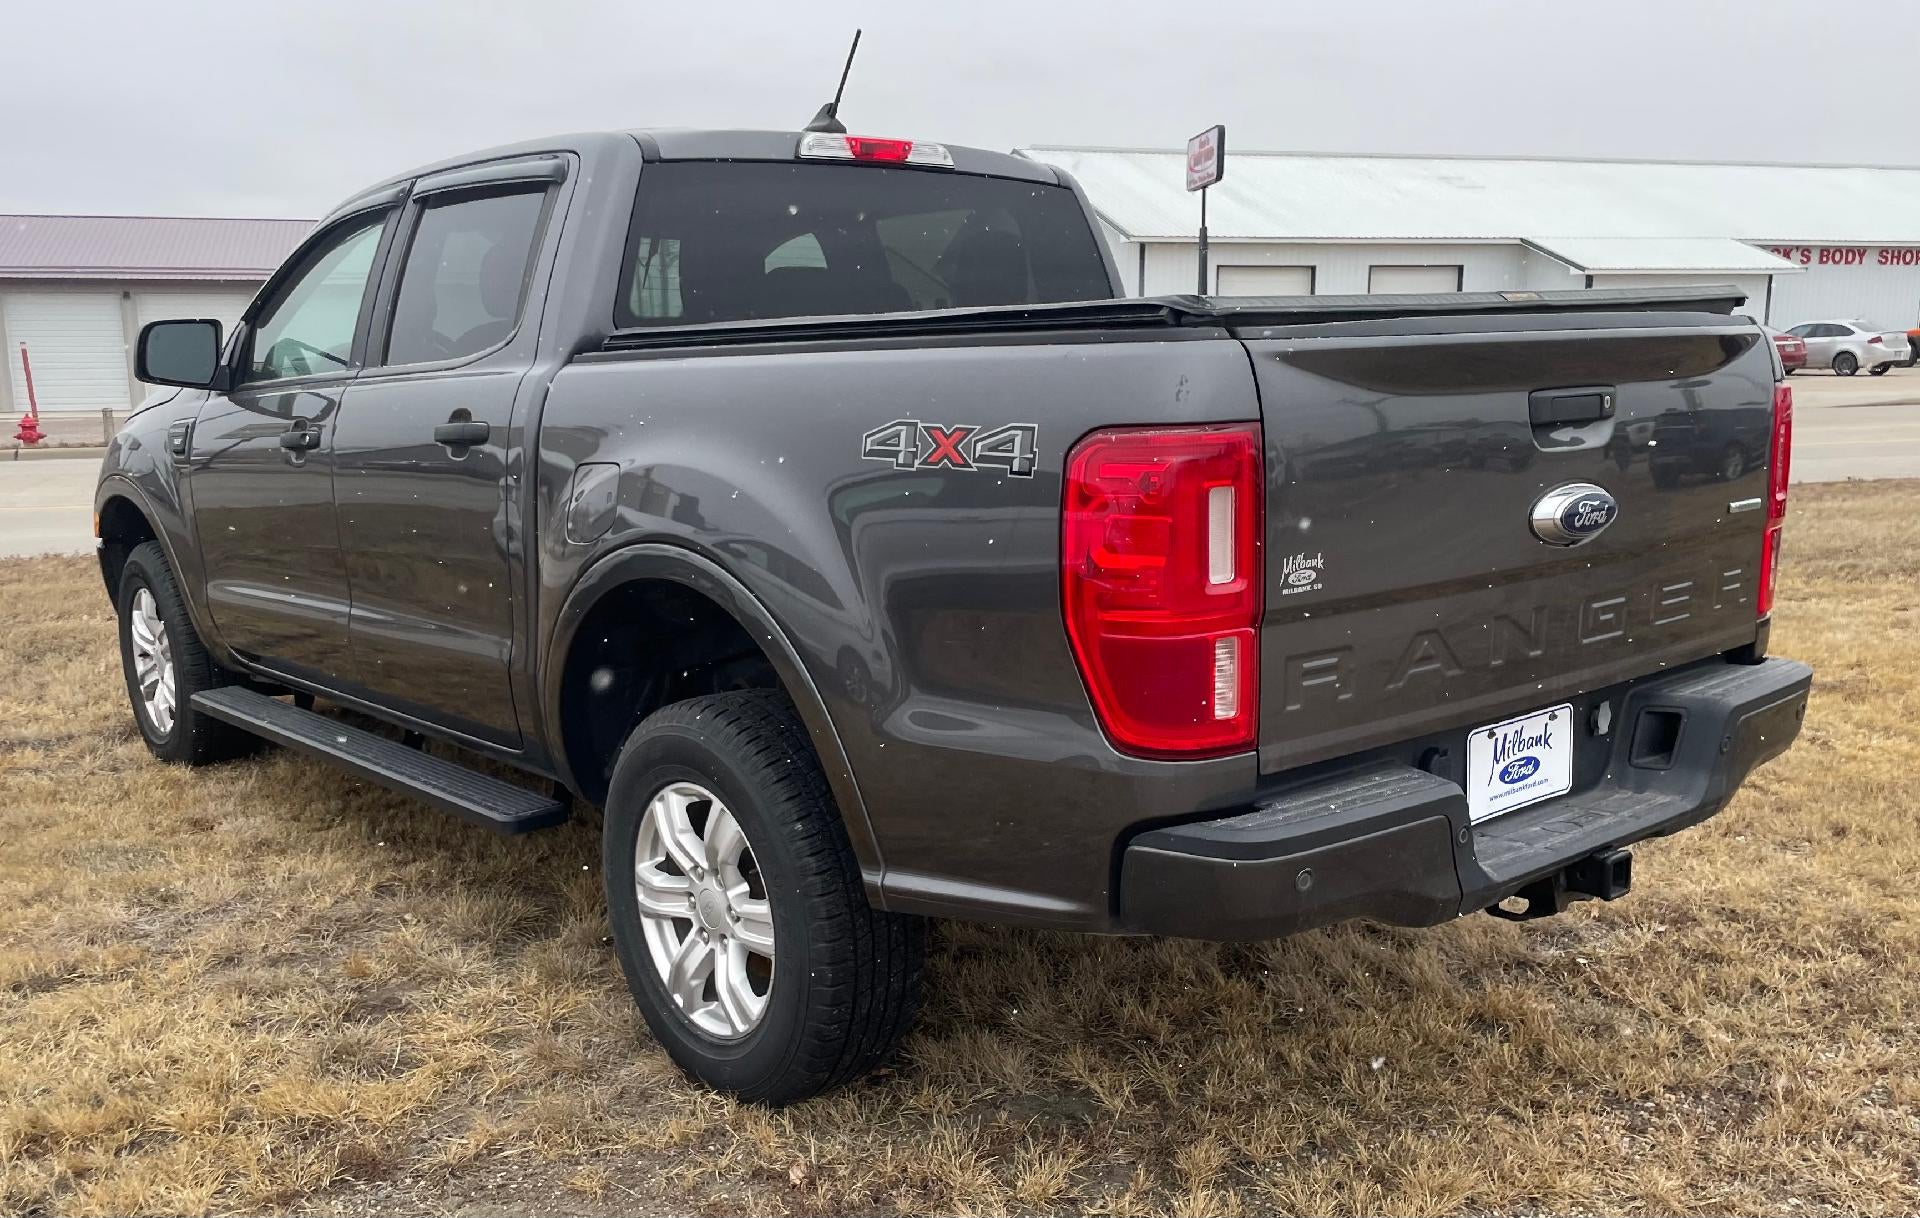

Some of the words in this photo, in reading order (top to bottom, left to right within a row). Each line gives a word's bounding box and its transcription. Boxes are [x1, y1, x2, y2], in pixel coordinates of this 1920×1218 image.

[1818, 248, 1867, 265] BODY
[1574, 500, 1609, 528] Ford
[1280, 552, 1325, 587] Milbank
[1284, 566, 1749, 712] RANGER
[1487, 722, 1553, 788] Milbank
[1504, 758, 1535, 782] Ford
[1489, 778, 1549, 802] www.milbankford.com
